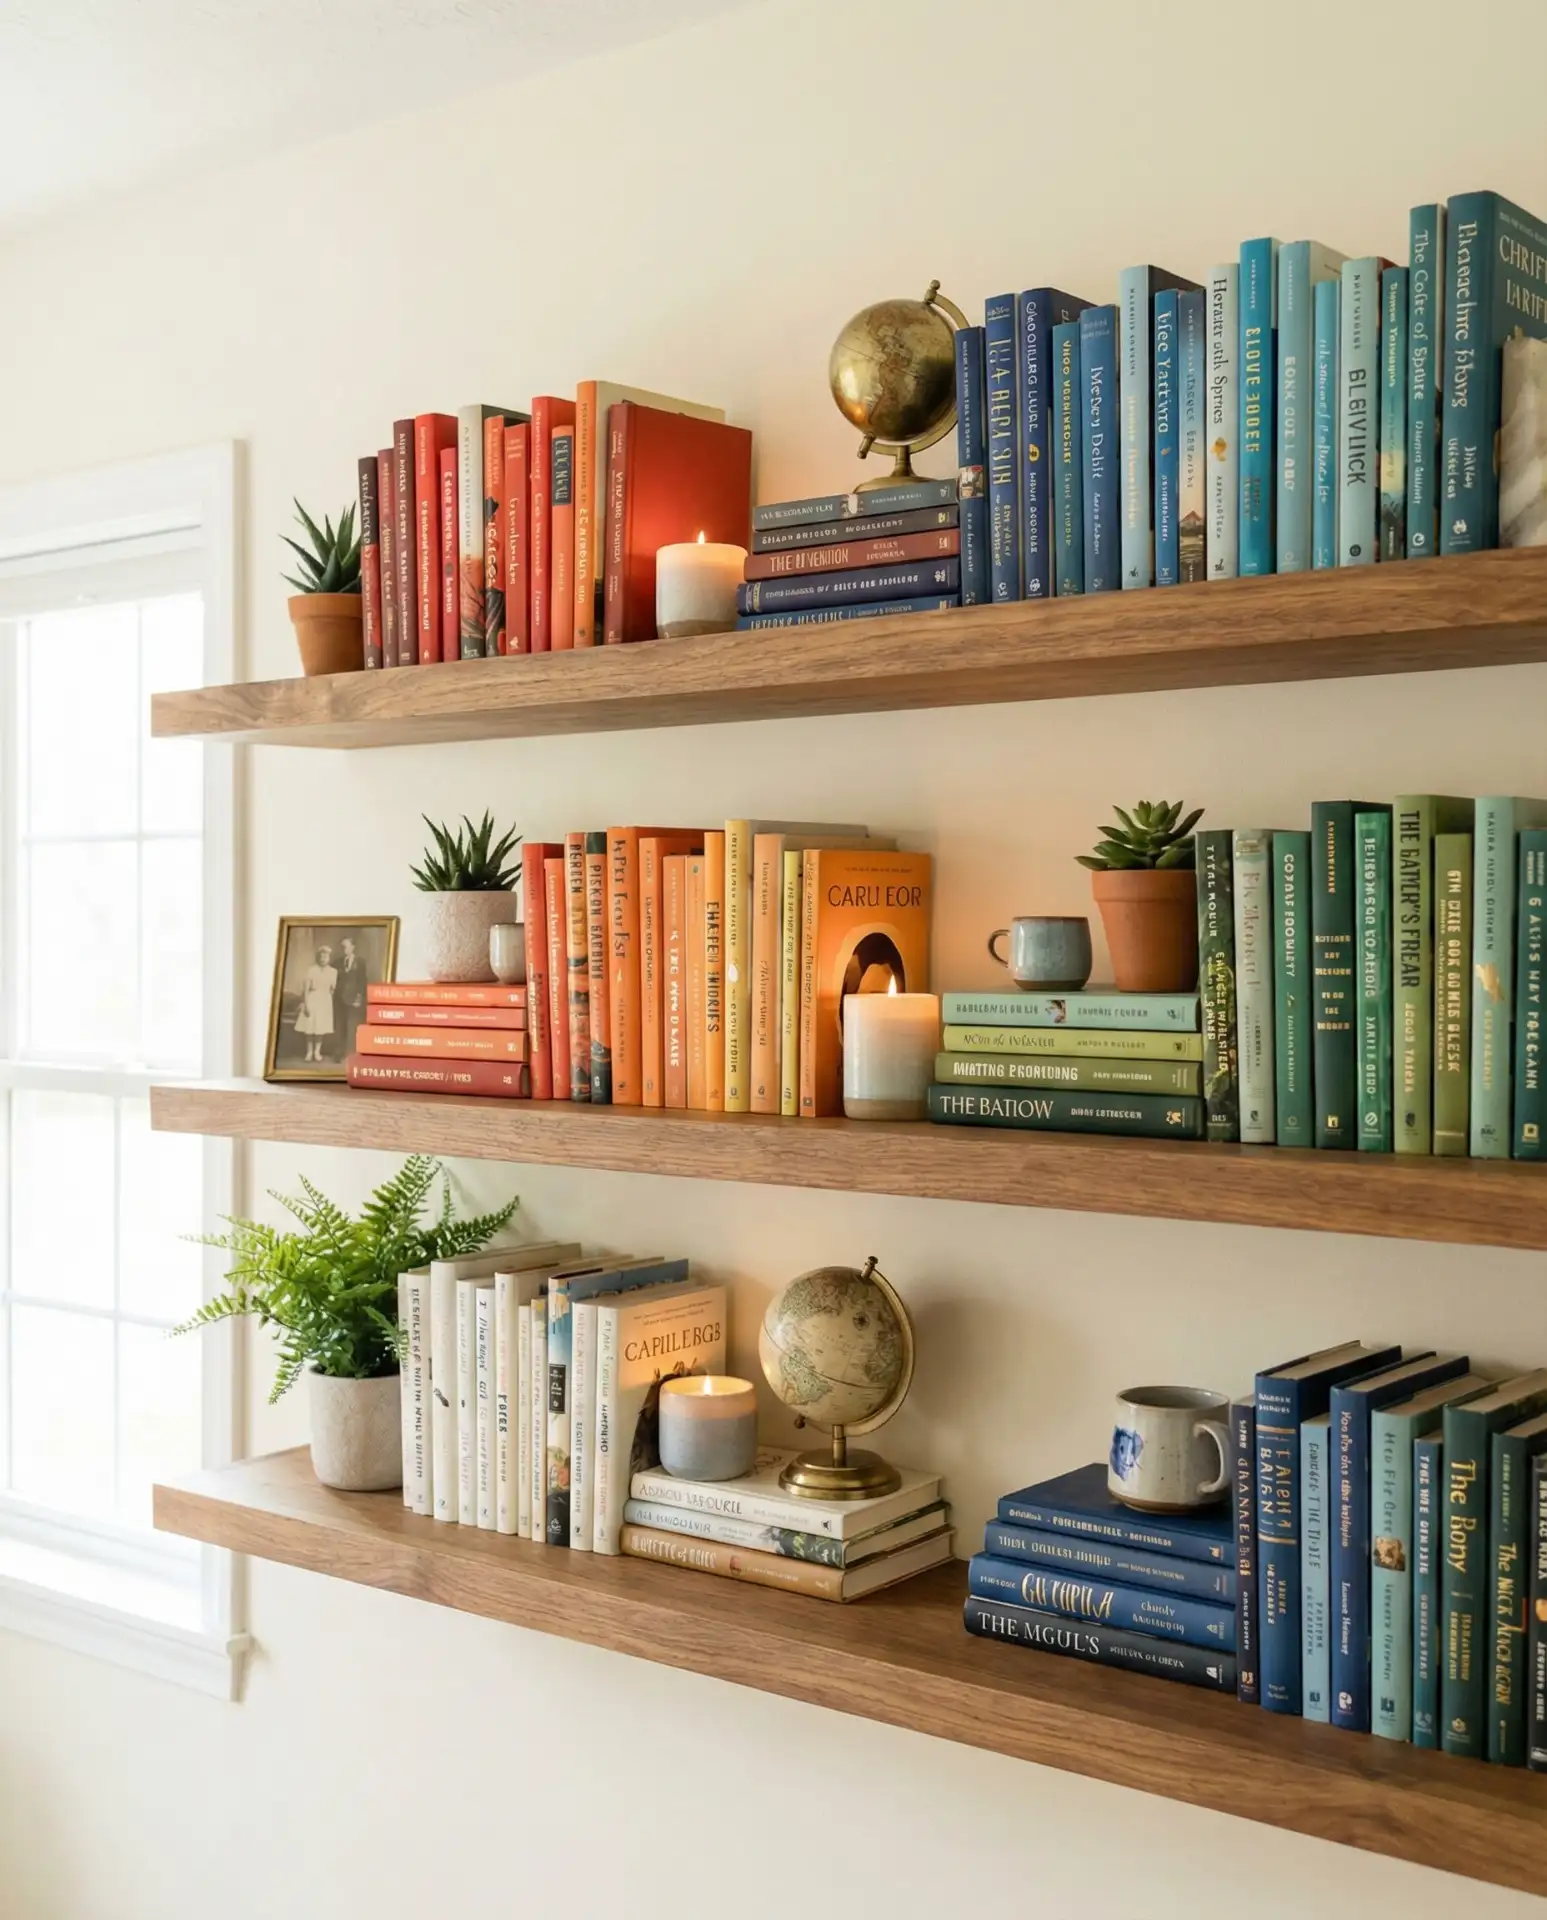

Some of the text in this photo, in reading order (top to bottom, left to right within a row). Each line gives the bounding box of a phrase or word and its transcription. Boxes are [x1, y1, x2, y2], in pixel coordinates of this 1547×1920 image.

[1414, 229, 1429, 264] The
[769, 555, 793, 573] THE
[1399, 810, 1421, 843] THE
[1398, 928, 1421, 988] FREAR
[939, 1096, 976, 1115] THE
[1449, 1458, 1478, 1504] The
[1497, 1541, 1518, 1571] The
[977, 1611, 1019, 1637] THE
